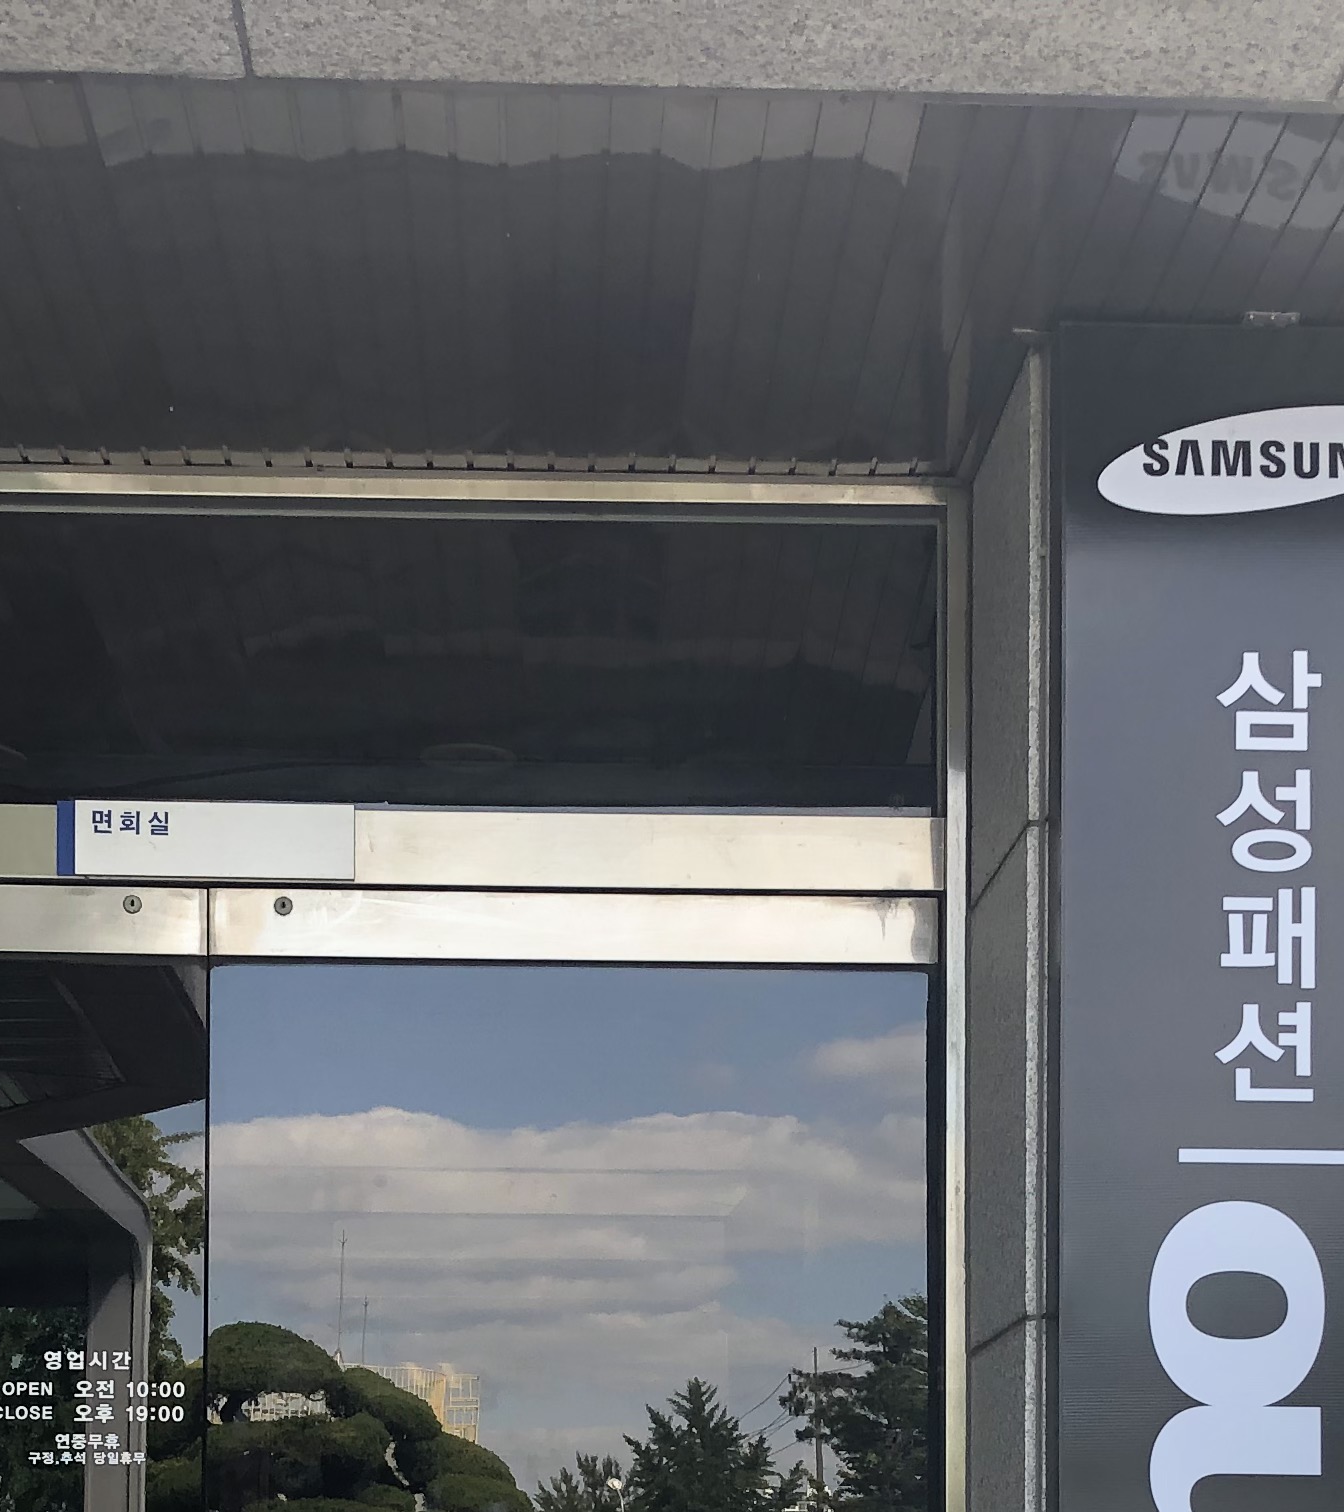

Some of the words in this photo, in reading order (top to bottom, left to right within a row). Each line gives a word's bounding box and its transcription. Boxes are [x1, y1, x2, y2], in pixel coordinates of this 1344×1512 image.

[91, 809, 170, 836] 면회실
[1215, 649, 1322, 1104] 삼성패션
[44, 1350, 132, 1371] 영업시간
[2, 1381, 54, 1396] OPEN
[73, 1380, 115, 1399] 오전
[126, 1381, 186, 1398] 10:00
[73, 1403, 115, 1423] 오후
[125, 1405, 185, 1422] 19:00
[55, 1433, 120, 1450] 연중무휴
